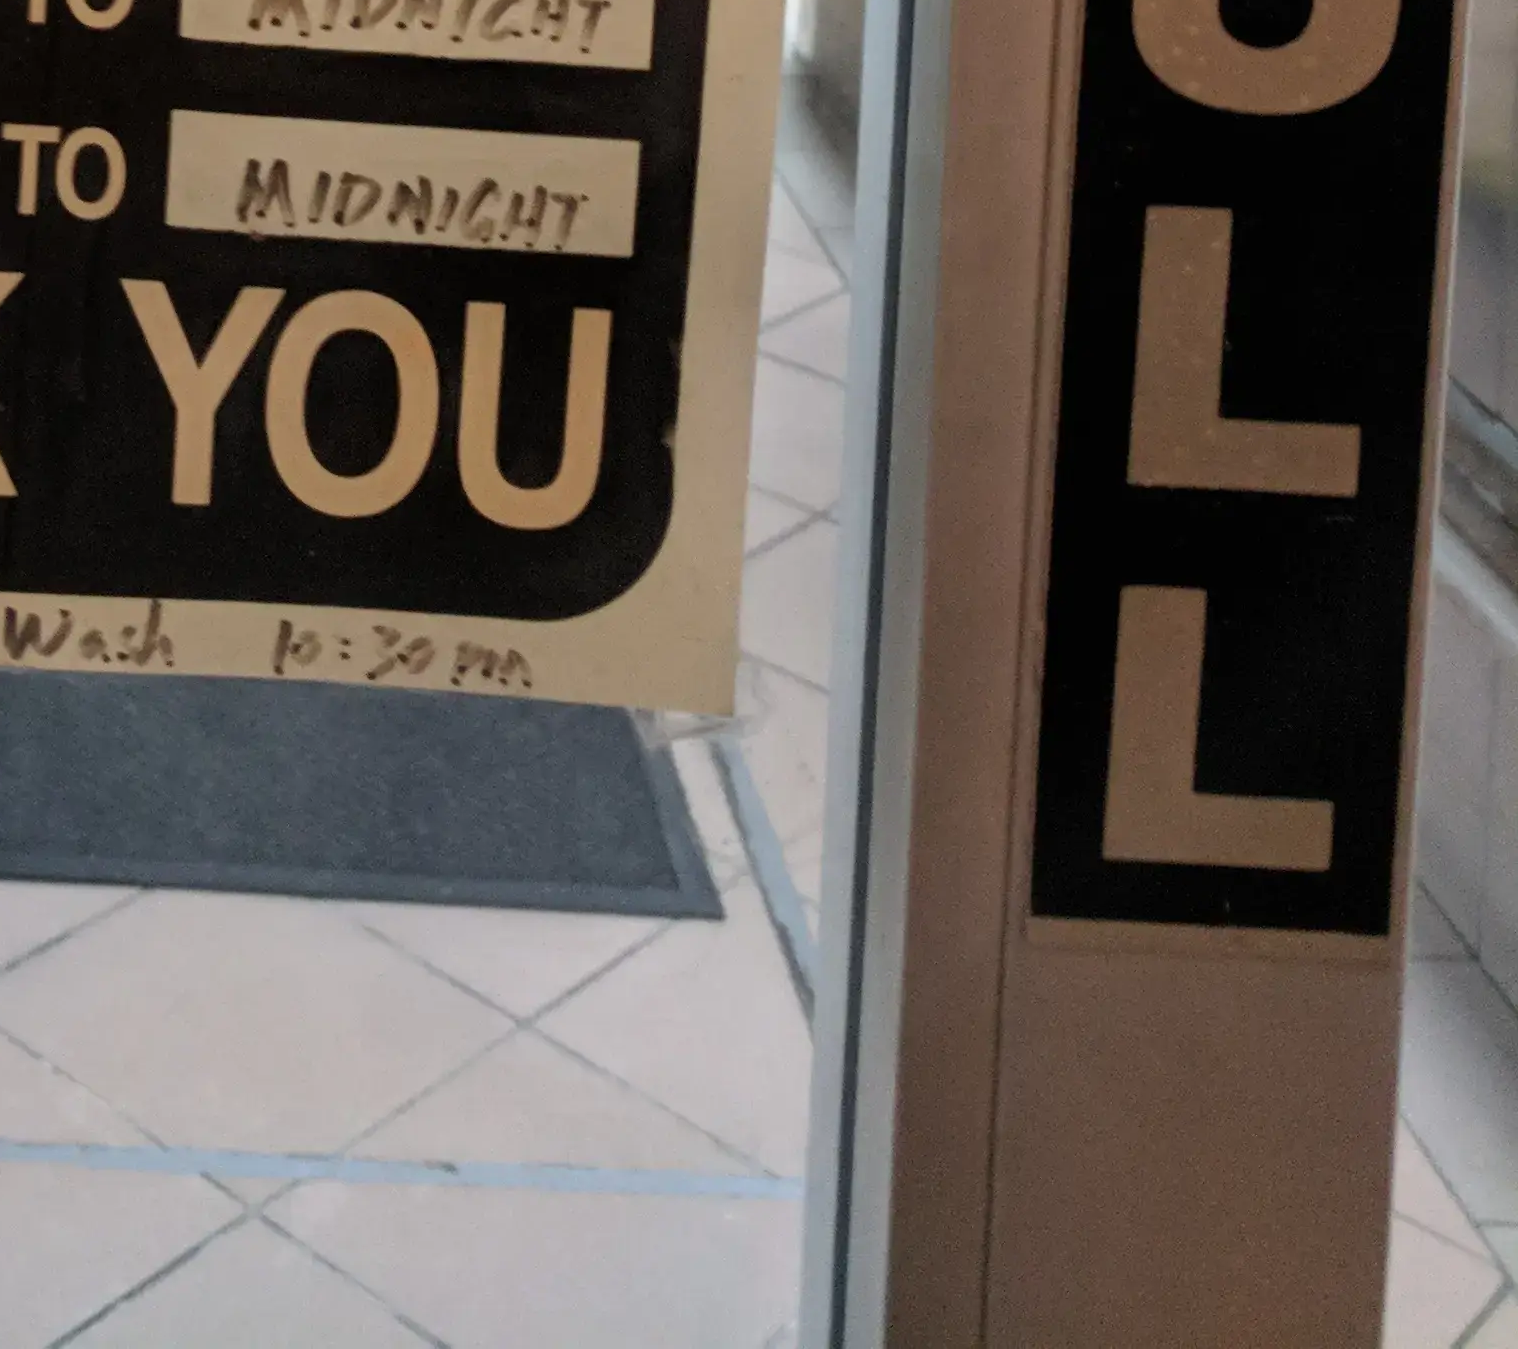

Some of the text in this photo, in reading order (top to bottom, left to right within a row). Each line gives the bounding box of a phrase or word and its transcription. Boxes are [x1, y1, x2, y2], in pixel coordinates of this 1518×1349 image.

[3, 124, 125, 219] TO
[235, 159, 589, 250] MIDNIGHT
[122, 279, 610, 528] YOU
